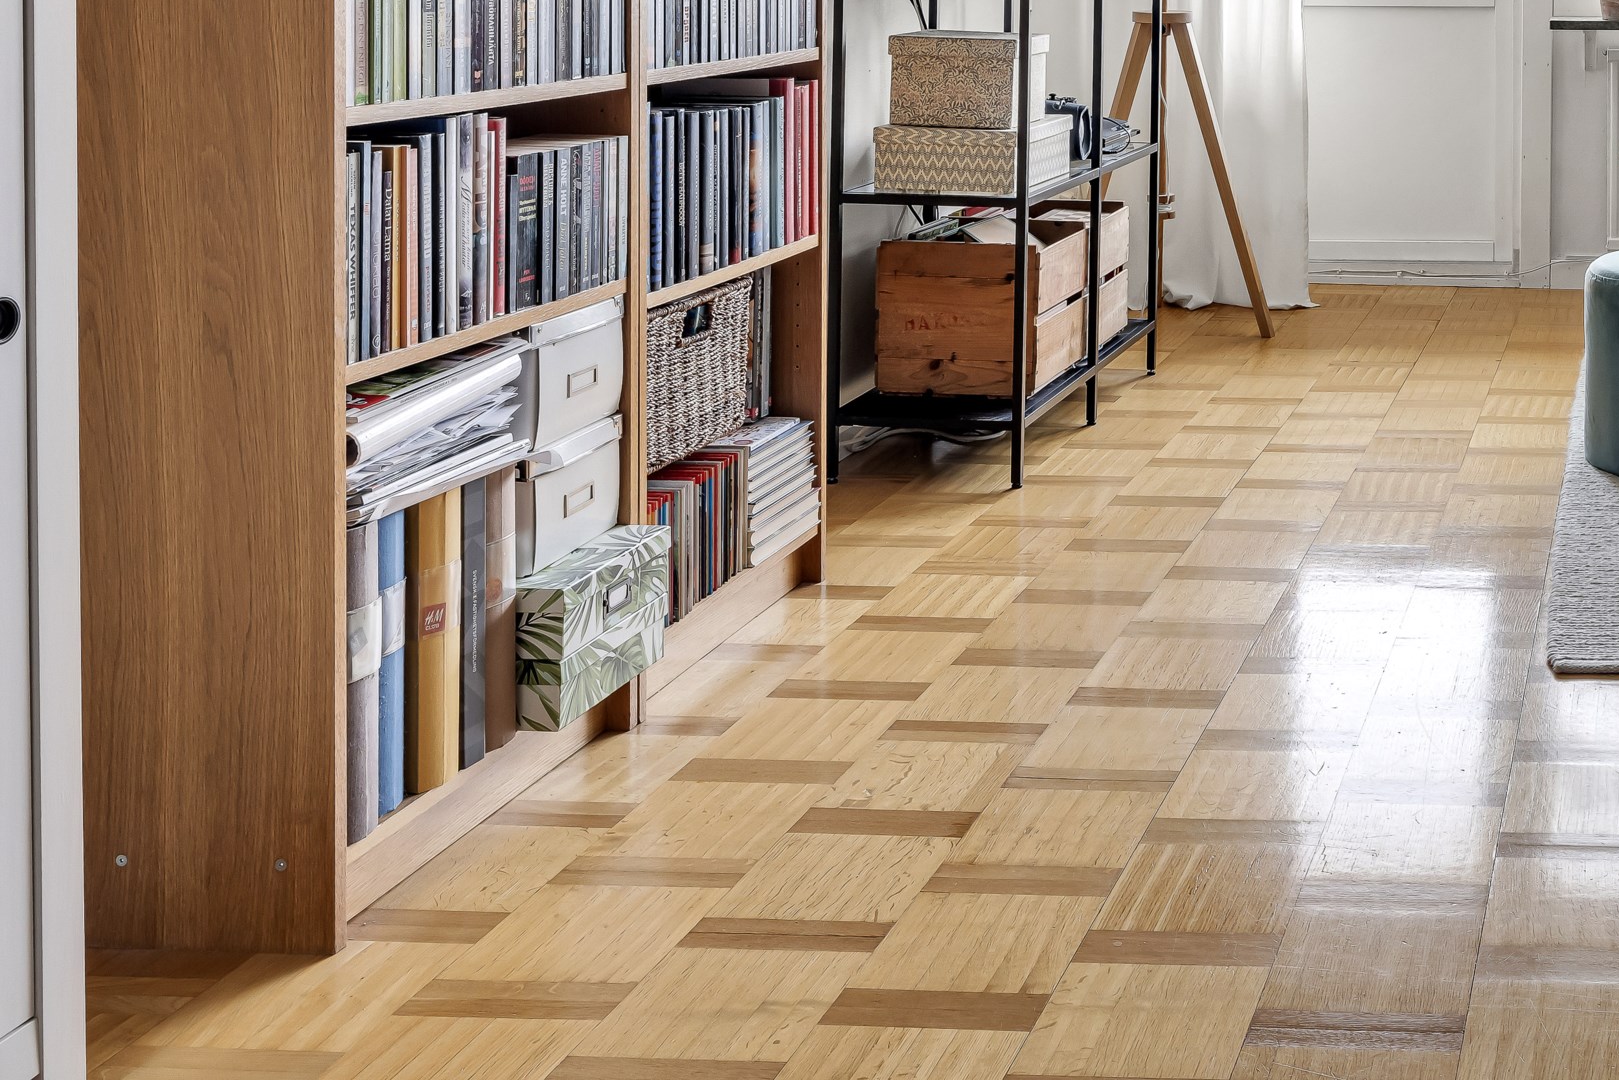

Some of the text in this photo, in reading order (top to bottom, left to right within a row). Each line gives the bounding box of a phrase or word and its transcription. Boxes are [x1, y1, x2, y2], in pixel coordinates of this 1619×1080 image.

[559, 157, 567, 188] ANNE
[559, 189, 567, 217] HOLT
[384, 187, 393, 262] Dalai Lama
[559, 221, 567, 244] Död
[424, 608, 445, 626] H&M
